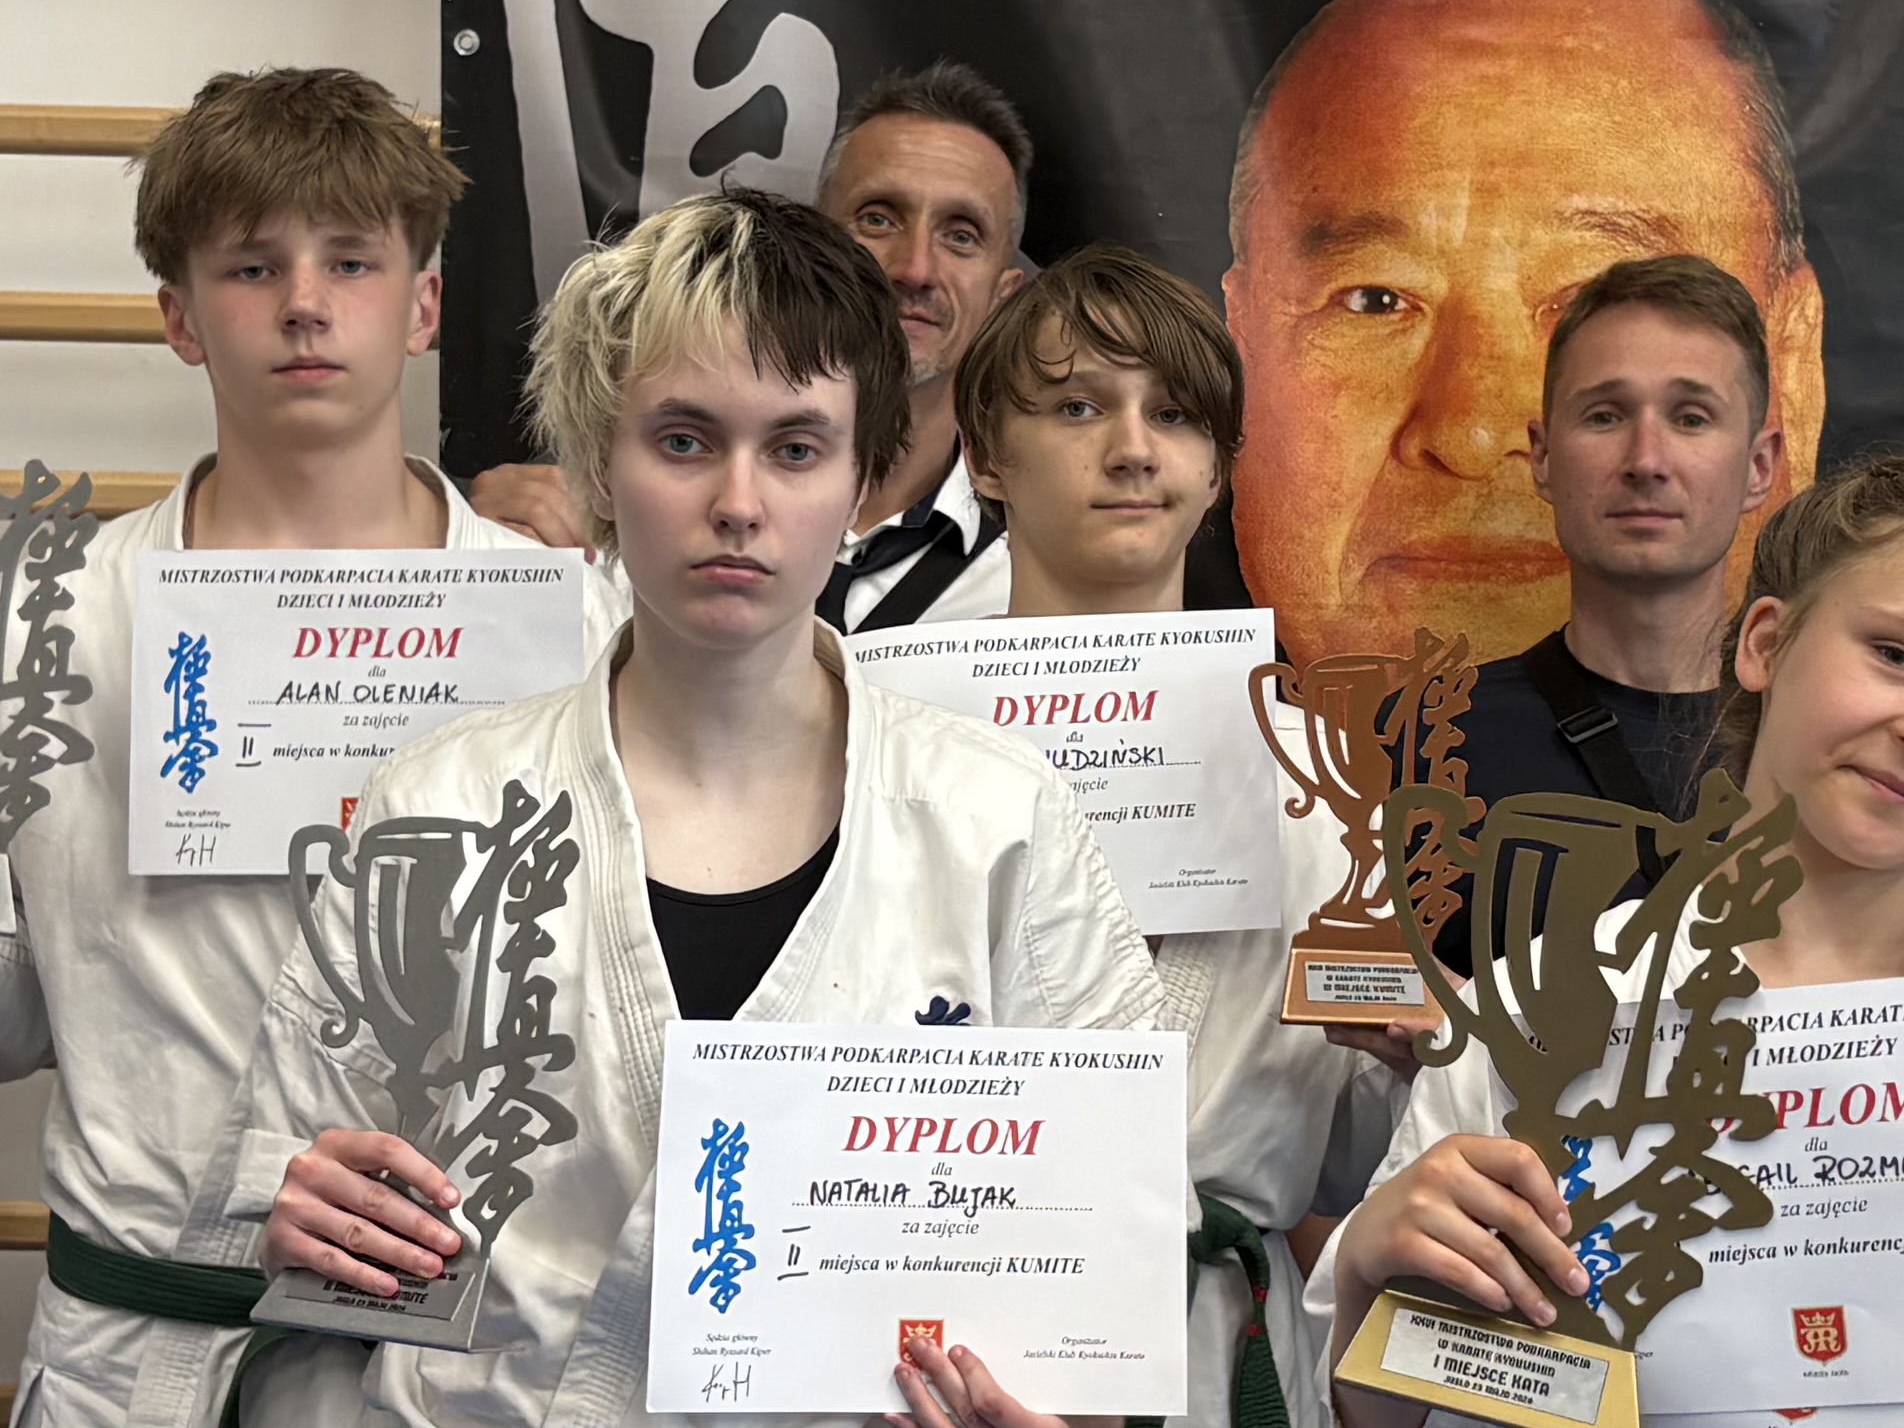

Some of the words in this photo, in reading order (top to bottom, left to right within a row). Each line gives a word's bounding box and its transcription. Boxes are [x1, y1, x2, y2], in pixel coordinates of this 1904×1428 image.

[159, 568, 276, 584] MISTRZOSTWA
[279, 568, 394, 584] PODKARPACIA
[397, 568, 463, 584] KARATE
[466, 568, 564, 584] KYOKUSHIN
[277, 593, 334, 609] DZIECI
[348, 592, 447, 609] MŁODZIEŻY
[292, 626, 465, 659] DYPLOM
[973, 635, 1090, 654] PODKARPACIA
[1093, 632, 1157, 649] KARATE
[1160, 627, 1256, 646] KYOKUSHIN
[367, 665, 387, 678] dla
[971, 661, 1029, 678] DZIECI
[1042, 655, 1141, 676] MŁODZIEŻY
[276, 681, 341, 705] ALAN
[993, 689, 1160, 727] DYPLOM
[342, 715, 360, 727] za
[272, 742, 326, 760] miejsca
[328, 746, 341, 758] w
[343, 742, 396, 758] konkur
[1045, 738, 1165, 771] UDZIŃSKI
[1131, 802, 1197, 820] KUMITE
[693, 1043, 827, 1064] MISTRZOSTWA
[831, 1045, 965, 1067] PODKARPACIA
[968, 1048, 1046, 1069] KARATE
[1049, 1051, 1165, 1071] KYOKUSHIN
[1752, 1048, 1761, 1067] I
[1765, 1034, 1898, 1067] MŁODZIEŻY
[826, 1075, 894, 1094] DZIECI
[896, 1077, 907, 1094] I
[908, 1076, 1026, 1097] MŁODZIEŻY
[843, 1115, 1046, 1157] DYPLOM
[1804, 1137, 1828, 1152] dla
[931, 1162, 953, 1178] dla
[809, 1180, 910, 1208] NATALIA
[927, 1181, 1018, 1218] BUJAK
[1780, 1203, 1801, 1218] za
[1804, 1195, 1868, 1220] zajęcie
[901, 1222, 921, 1235] za
[923, 1219, 980, 1237] zajęcie
[1708, 1242, 1777, 1265] miejsca
[1782, 1241, 1798, 1257] w
[819, 1255, 881, 1275] miejsca
[884, 1259, 899, 1272] w
[902, 1255, 1003, 1276] konkurencji
[1005, 1256, 1085, 1275] KUMITE
[1443, 1356, 1509, 1387] MIEJSCE
[1511, 1371, 1551, 1397] KATA
